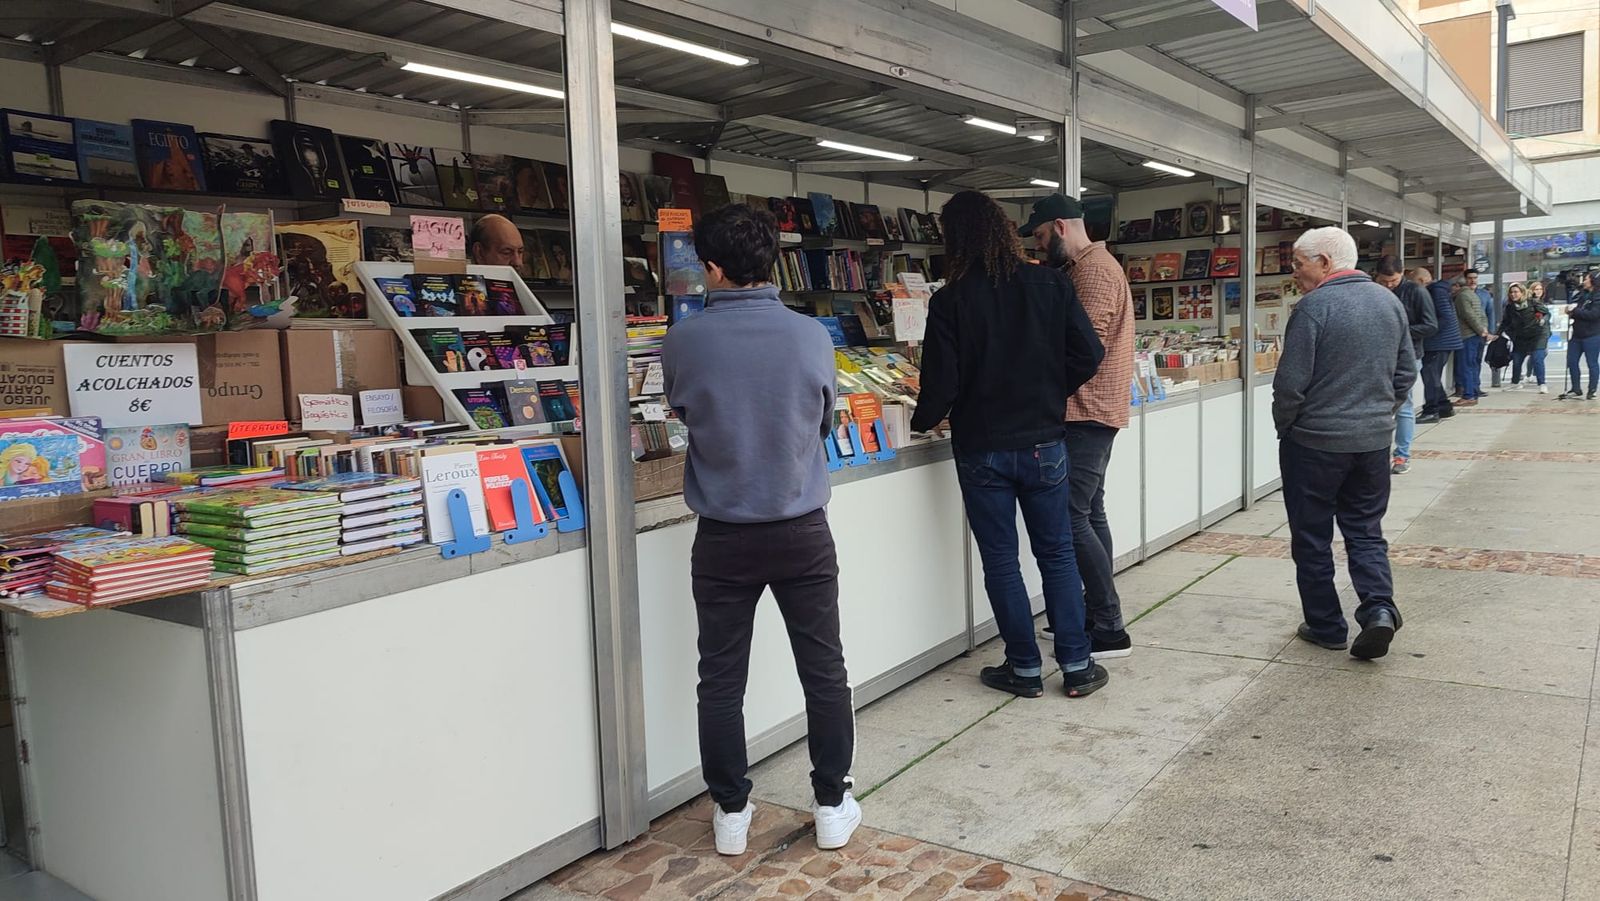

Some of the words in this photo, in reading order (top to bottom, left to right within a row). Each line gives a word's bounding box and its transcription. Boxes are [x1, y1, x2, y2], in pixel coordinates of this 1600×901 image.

[148, 132, 188, 149] EGIPTO
[96, 354, 174, 369] CUENTOS
[76, 376, 194, 392] ACOLCHADOS
[208, 382, 263, 401] Grupo
[4, 395, 51, 405] JUEGO
[128, 399, 152, 413] 8€
[230, 422, 287, 434] LITERATURA
[111, 452, 145, 463] GRAN
[150, 449, 183, 460] LIBRO
[425, 469, 478, 483] Leroux
